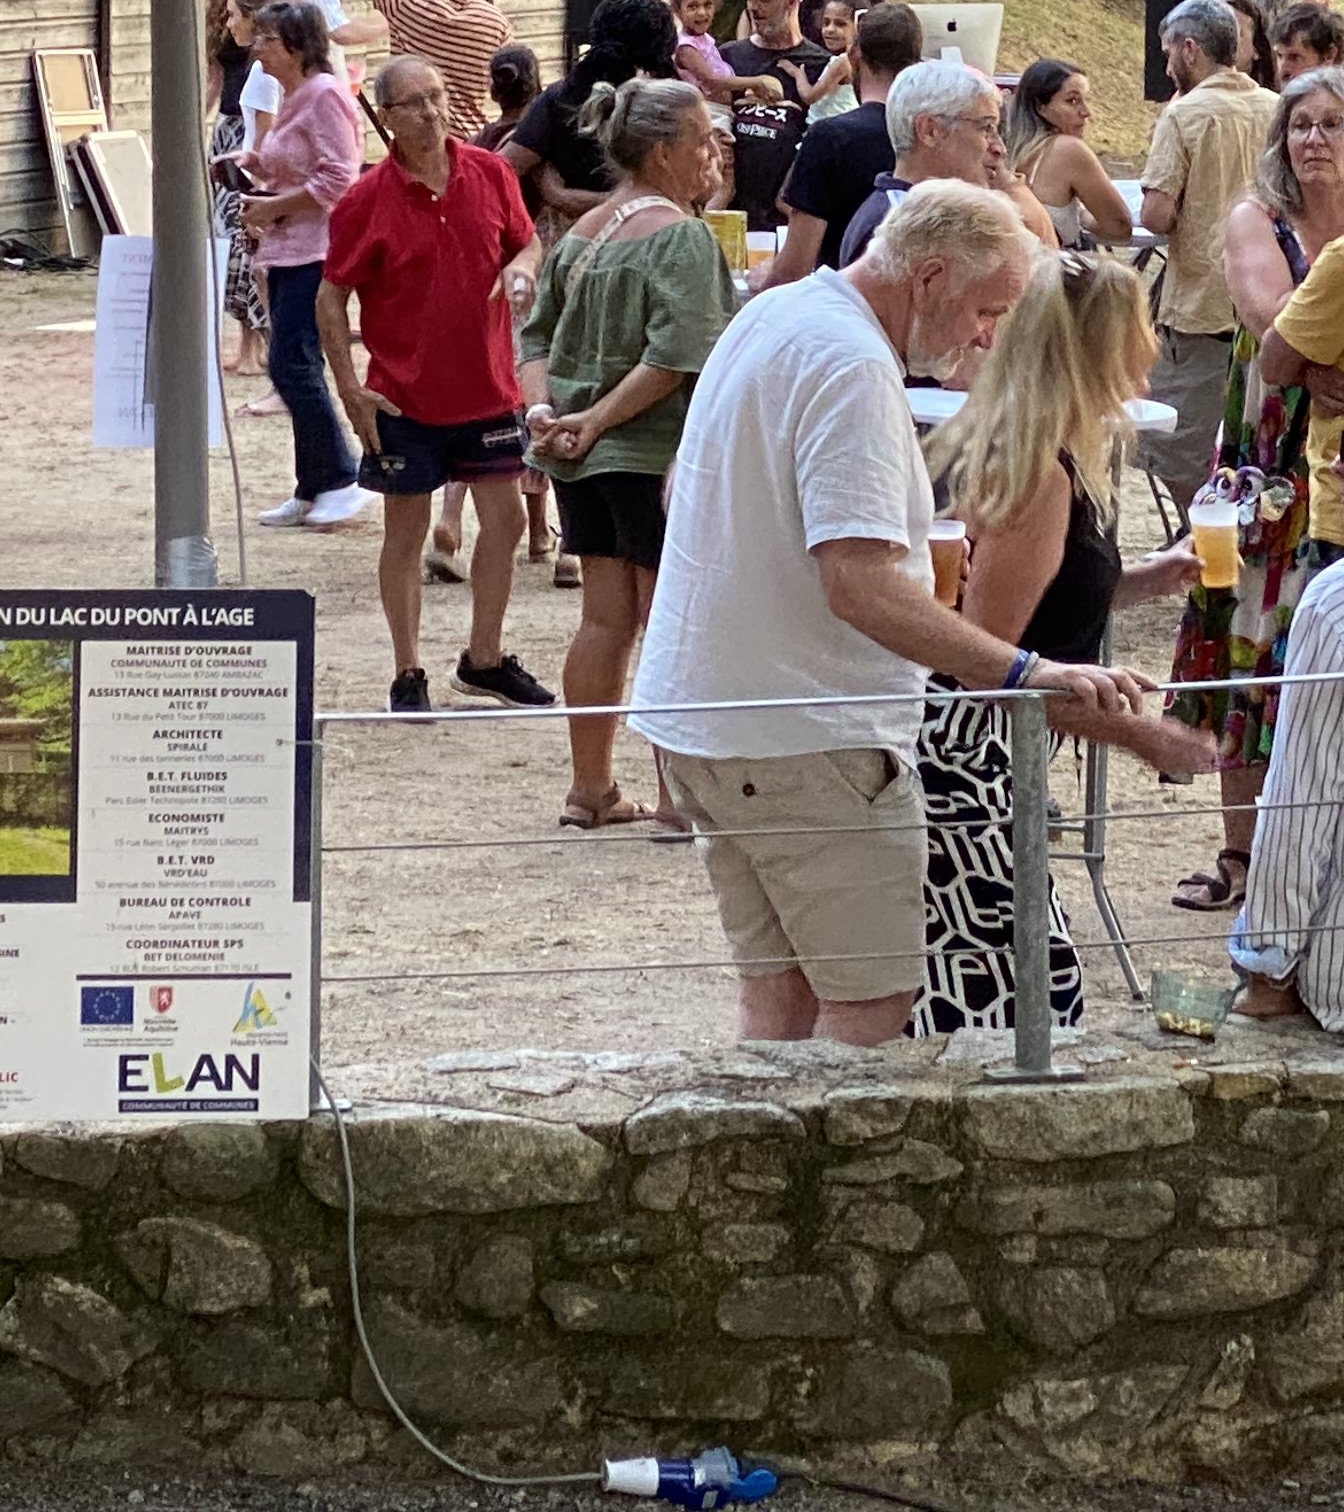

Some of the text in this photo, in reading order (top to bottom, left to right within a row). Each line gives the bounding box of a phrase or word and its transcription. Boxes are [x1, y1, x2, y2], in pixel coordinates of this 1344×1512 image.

[16, 607, 46, 625] DU
[50, 607, 87, 625] LAC
[91, 607, 120, 625] DU
[125, 607, 181, 626] PONT
[183, 603, 198, 626] À
[126, 646, 180, 656] MAITRISE
[110, 659, 268, 668] COMMUNAUTE DE COMMUNES
[88, 688, 160, 697] ASSISTANCE
[162, 688, 218, 697] MAITRISE
[168, 701, 194, 710] ATEC
[152, 730, 224, 739] ARCHITECTE
[167, 743, 208, 752] SPIRALE
[180, 772, 228, 781] FLUIDES
[148, 813, 225, 822] ECONOMISTE
[164, 826, 209, 835] MAITRYS
[190, 856, 215, 865] VRD
[119, 898, 251, 907] BUREAU DE CONTROLE
[168, 911, 202, 920] APAVE
[126, 940, 244, 949] COORDINATEUR SPS
[144, 953, 162, 961] BET
[118, 1052, 260, 1094] ELAN
[190, 1101, 201, 1110] DE
